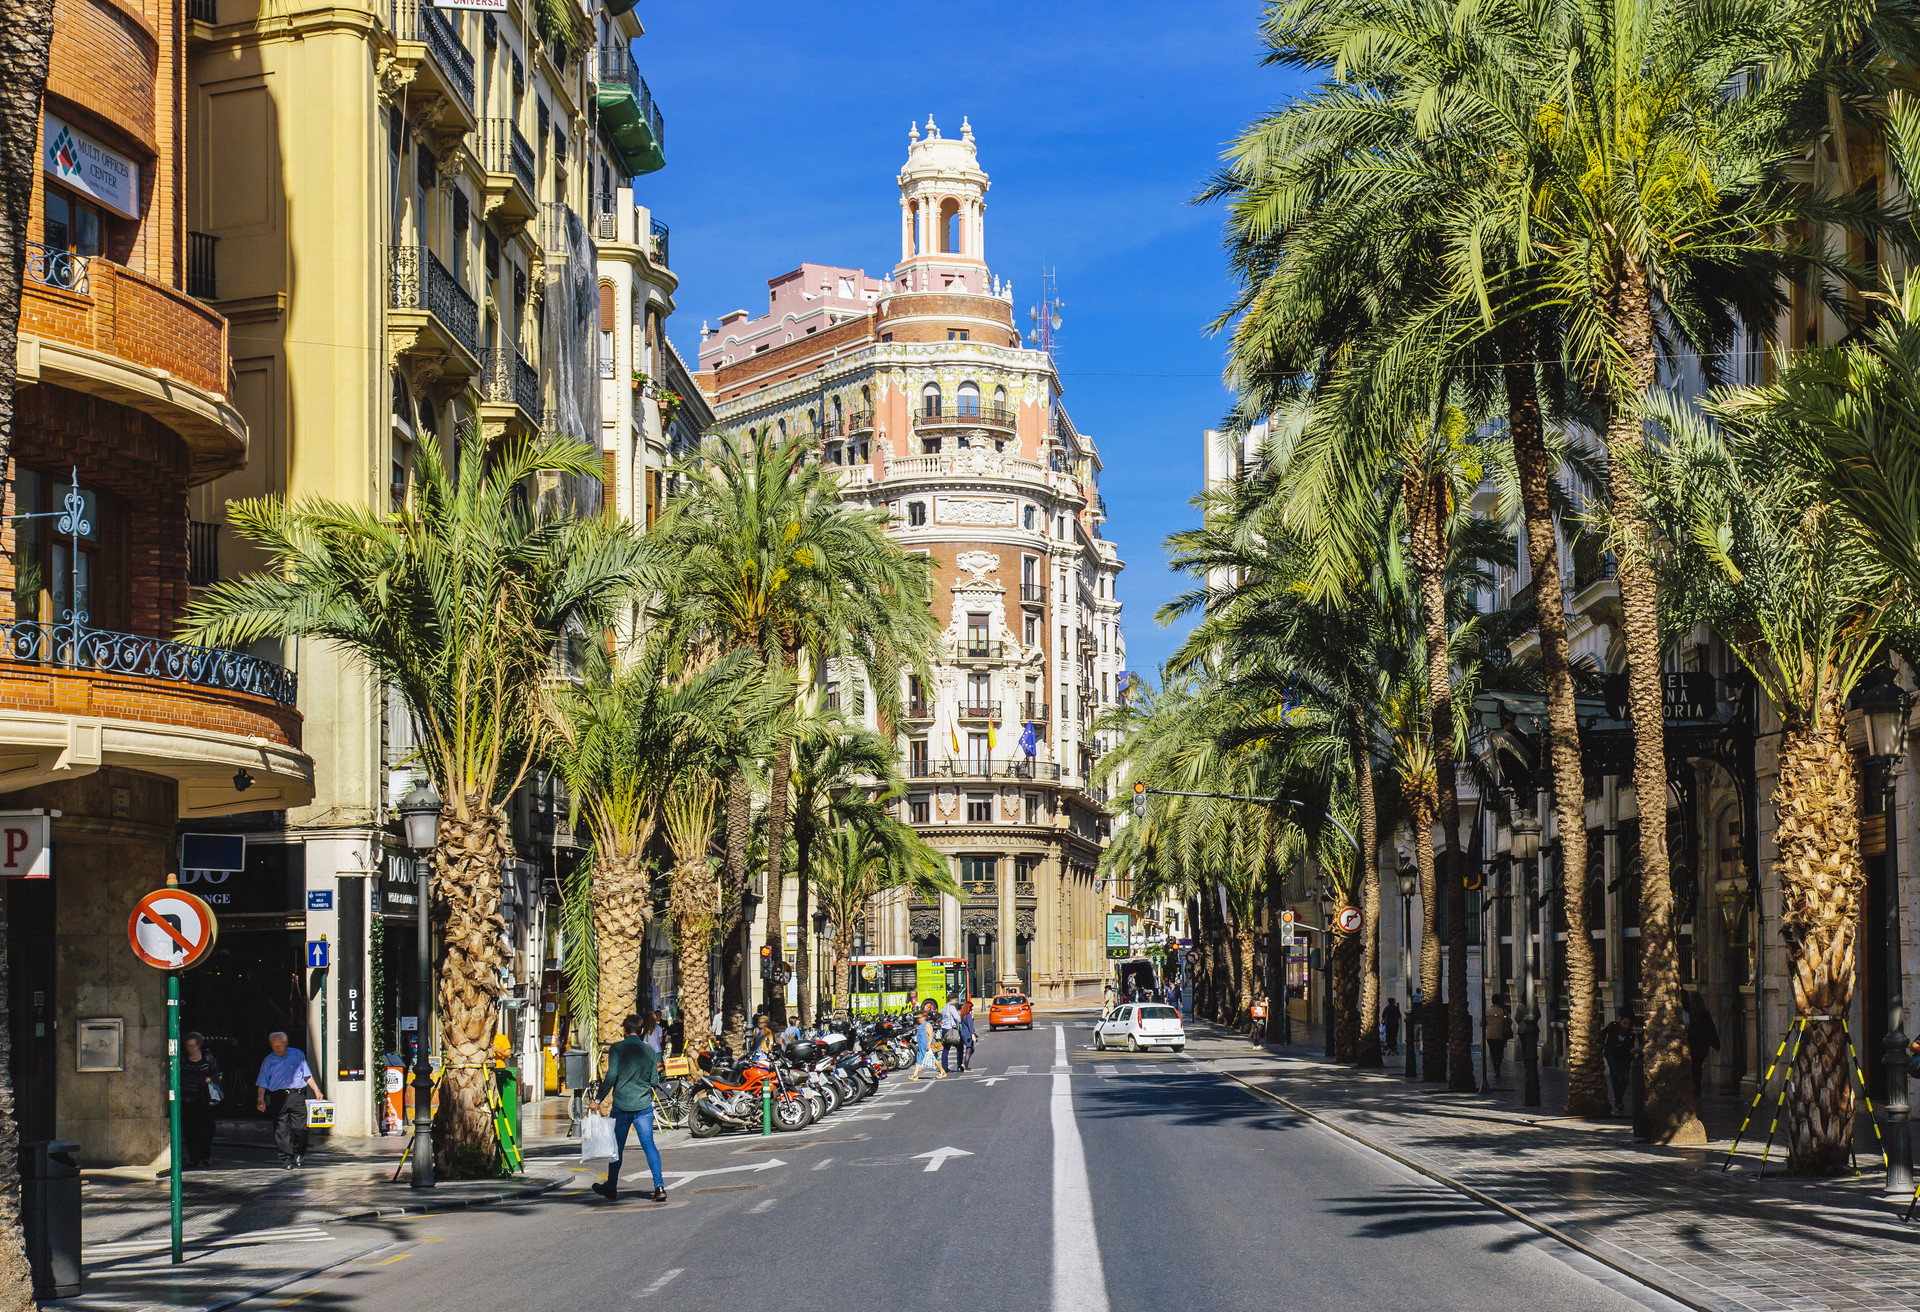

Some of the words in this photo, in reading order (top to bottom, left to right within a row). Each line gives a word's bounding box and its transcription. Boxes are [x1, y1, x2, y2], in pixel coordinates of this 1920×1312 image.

[78, 139, 100, 162] MULTI
[101, 152, 129, 178] OFFICES
[90, 163, 117, 189] CENTER
[1618, 704, 1703, 719] VORIA
[4, 828, 28, 868] P
[920, 835, 956, 847] ANCO
[961, 834, 978, 845] DE
[387, 854, 419, 885] DODO
[203, 893, 231, 904] NGE
[349, 989, 358, 1032] BIKE
